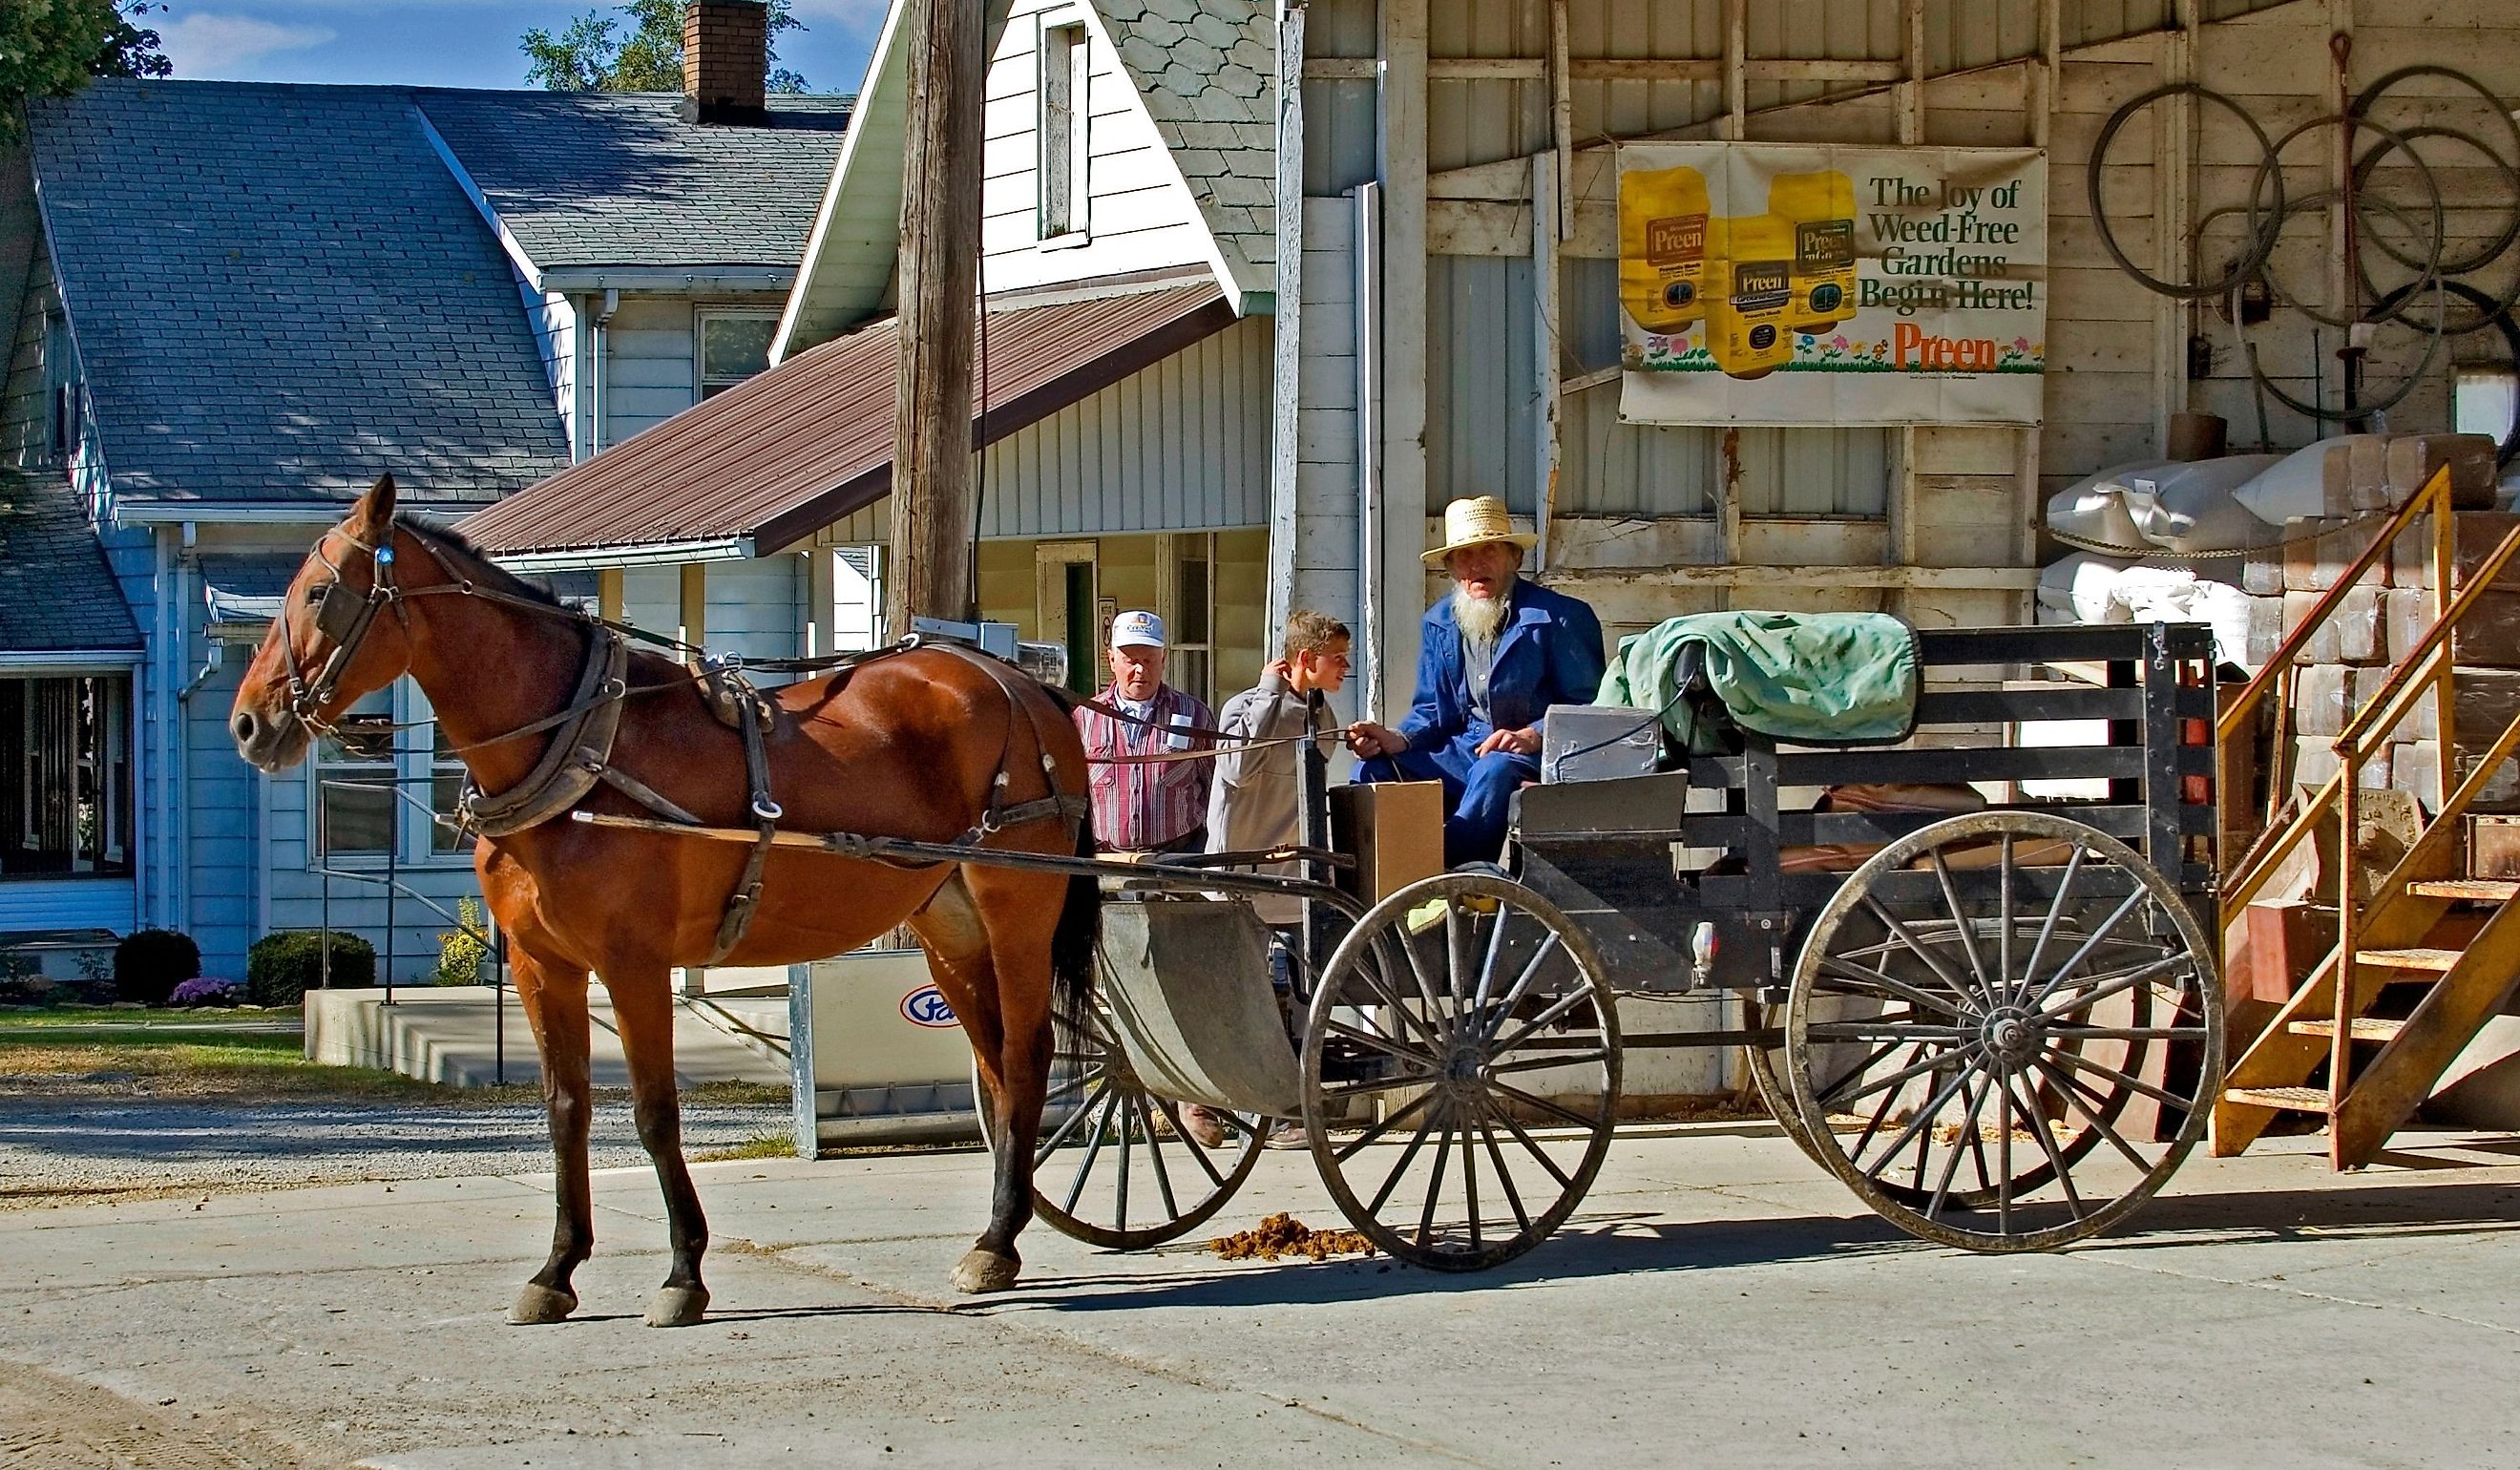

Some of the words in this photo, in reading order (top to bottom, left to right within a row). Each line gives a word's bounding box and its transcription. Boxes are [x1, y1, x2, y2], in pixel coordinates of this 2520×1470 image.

[1869, 178, 1930, 207] The
[1933, 178, 1985, 215] Joy
[1990, 179, 2022, 209] of
[1654, 228, 1702, 252] Preen
[1804, 232, 1846, 251] Preen
[1868, 213, 2019, 244] Weed-Free
[1880, 246, 2007, 277] Gardens
[1741, 273, 1782, 292] Preen
[1858, 279, 1949, 317] Begin
[1956, 280, 2033, 310] Here!
[1894, 323, 1997, 373] Preen
